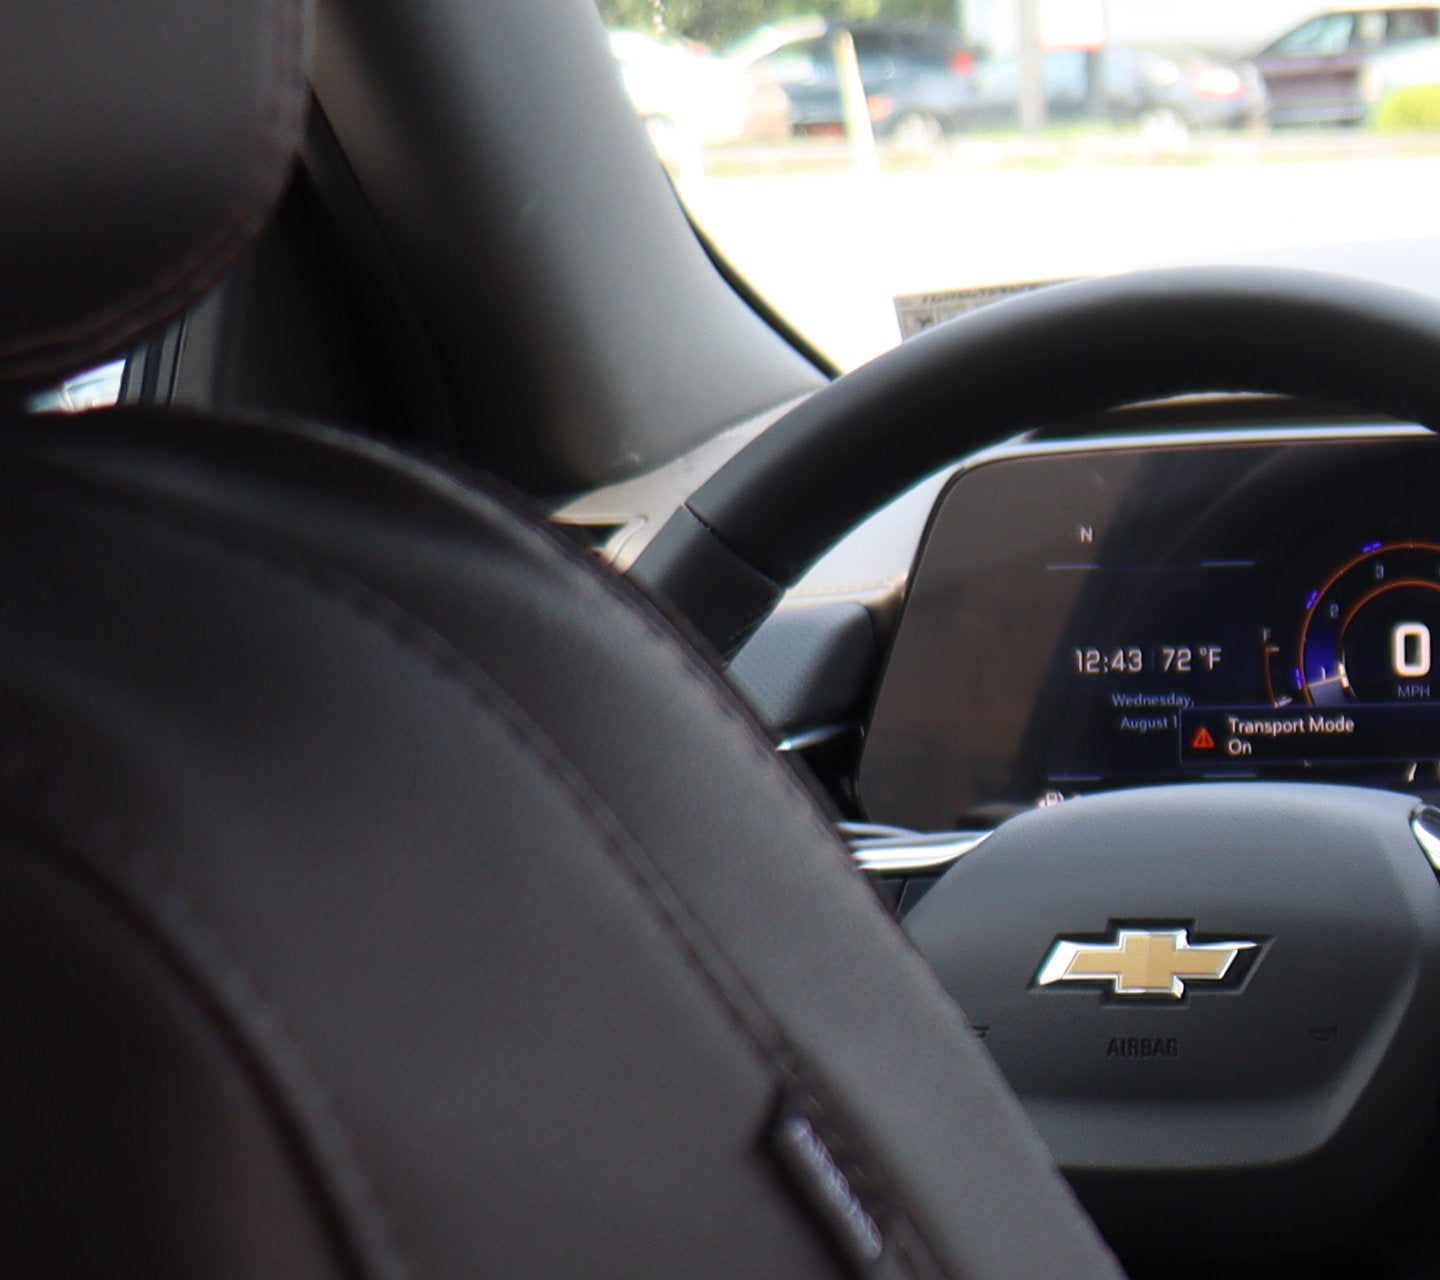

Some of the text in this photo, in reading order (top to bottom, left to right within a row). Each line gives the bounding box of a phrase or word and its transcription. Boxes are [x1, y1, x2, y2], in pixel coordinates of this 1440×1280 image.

[1079, 526, 1093, 543] N
[1393, 622, 1431, 677] 0
[1075, 648, 1143, 674] 12:43
[1162, 647, 1192, 672] 72
[1397, 683, 1430, 697] MPH
[1111, 692, 1195, 709] Wednesday,
[1120, 715, 1168, 733] August
[1228, 715, 1355, 738] Transport Mode
[1227, 737, 1252, 755] On
[1106, 1037, 1180, 1058] AIRBAG
